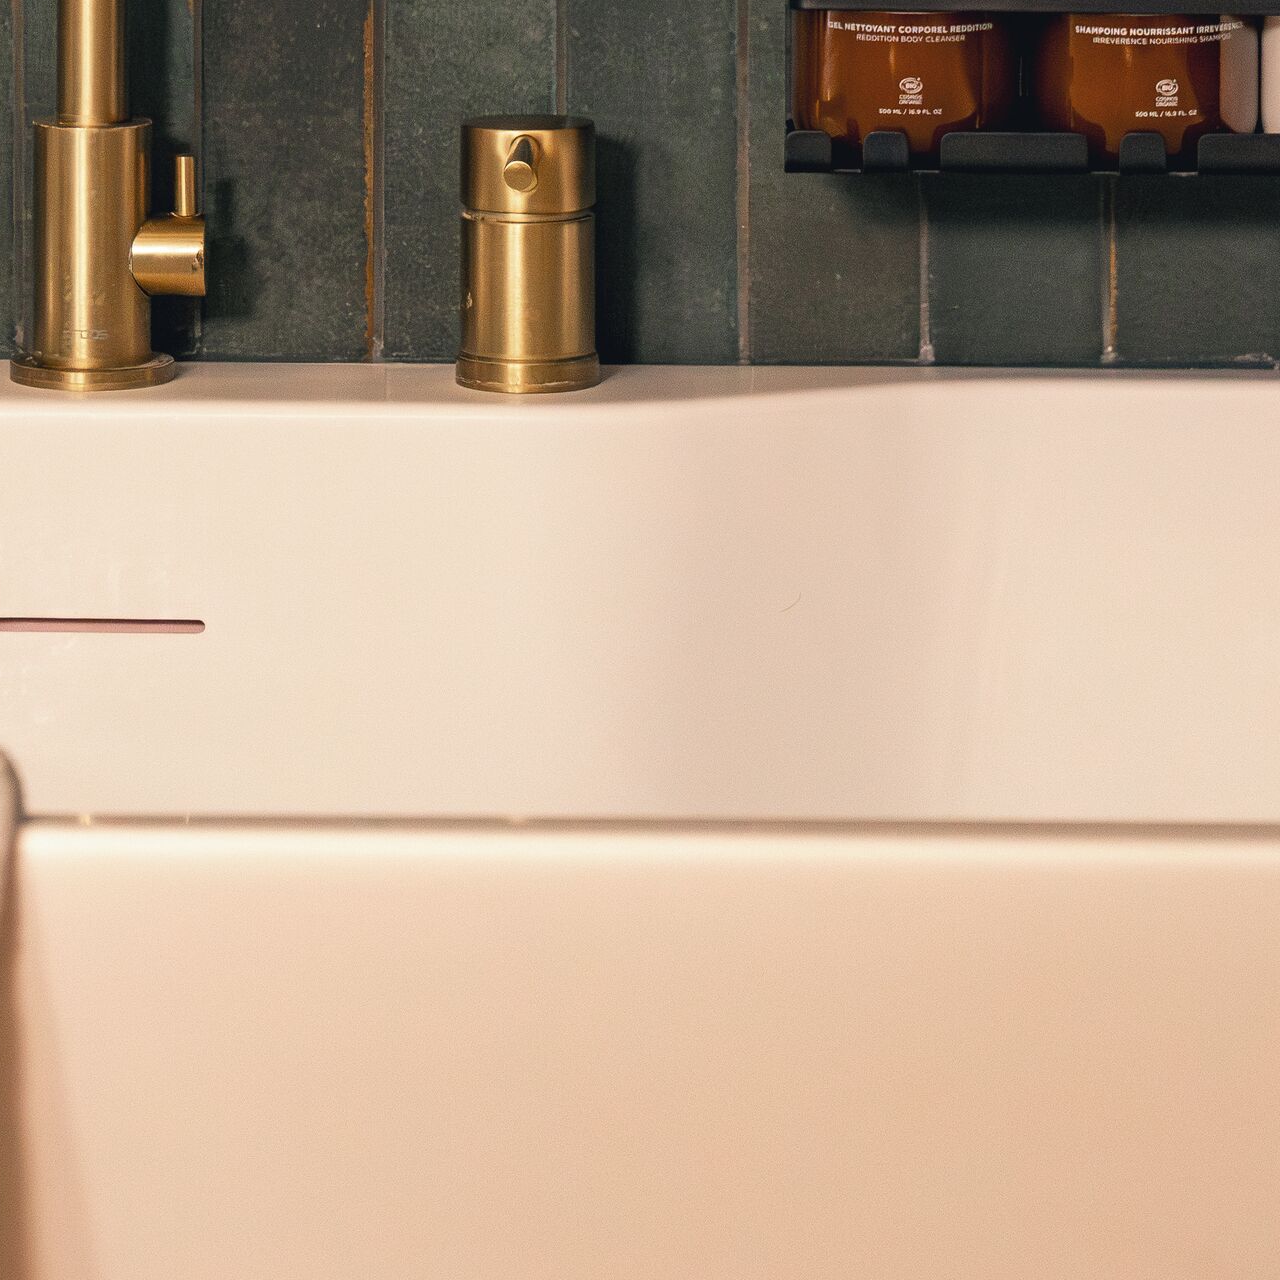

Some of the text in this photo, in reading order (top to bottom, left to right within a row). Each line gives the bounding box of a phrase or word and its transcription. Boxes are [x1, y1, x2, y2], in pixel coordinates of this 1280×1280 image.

[828, 21, 843, 30] GEL
[844, 22, 896, 33] NETTOYANT
[898, 25, 948, 34] CORPOREL
[1075, 24, 1128, 36] SHAMPOING
[1129, 26, 1195, 37] NOURRISSANT
[856, 33, 966, 43] REDDITION BODY CLEANSER
[1092, 37, 1148, 46] IRREVERENCE
[1149, 36, 1199, 46] NOURISHING
